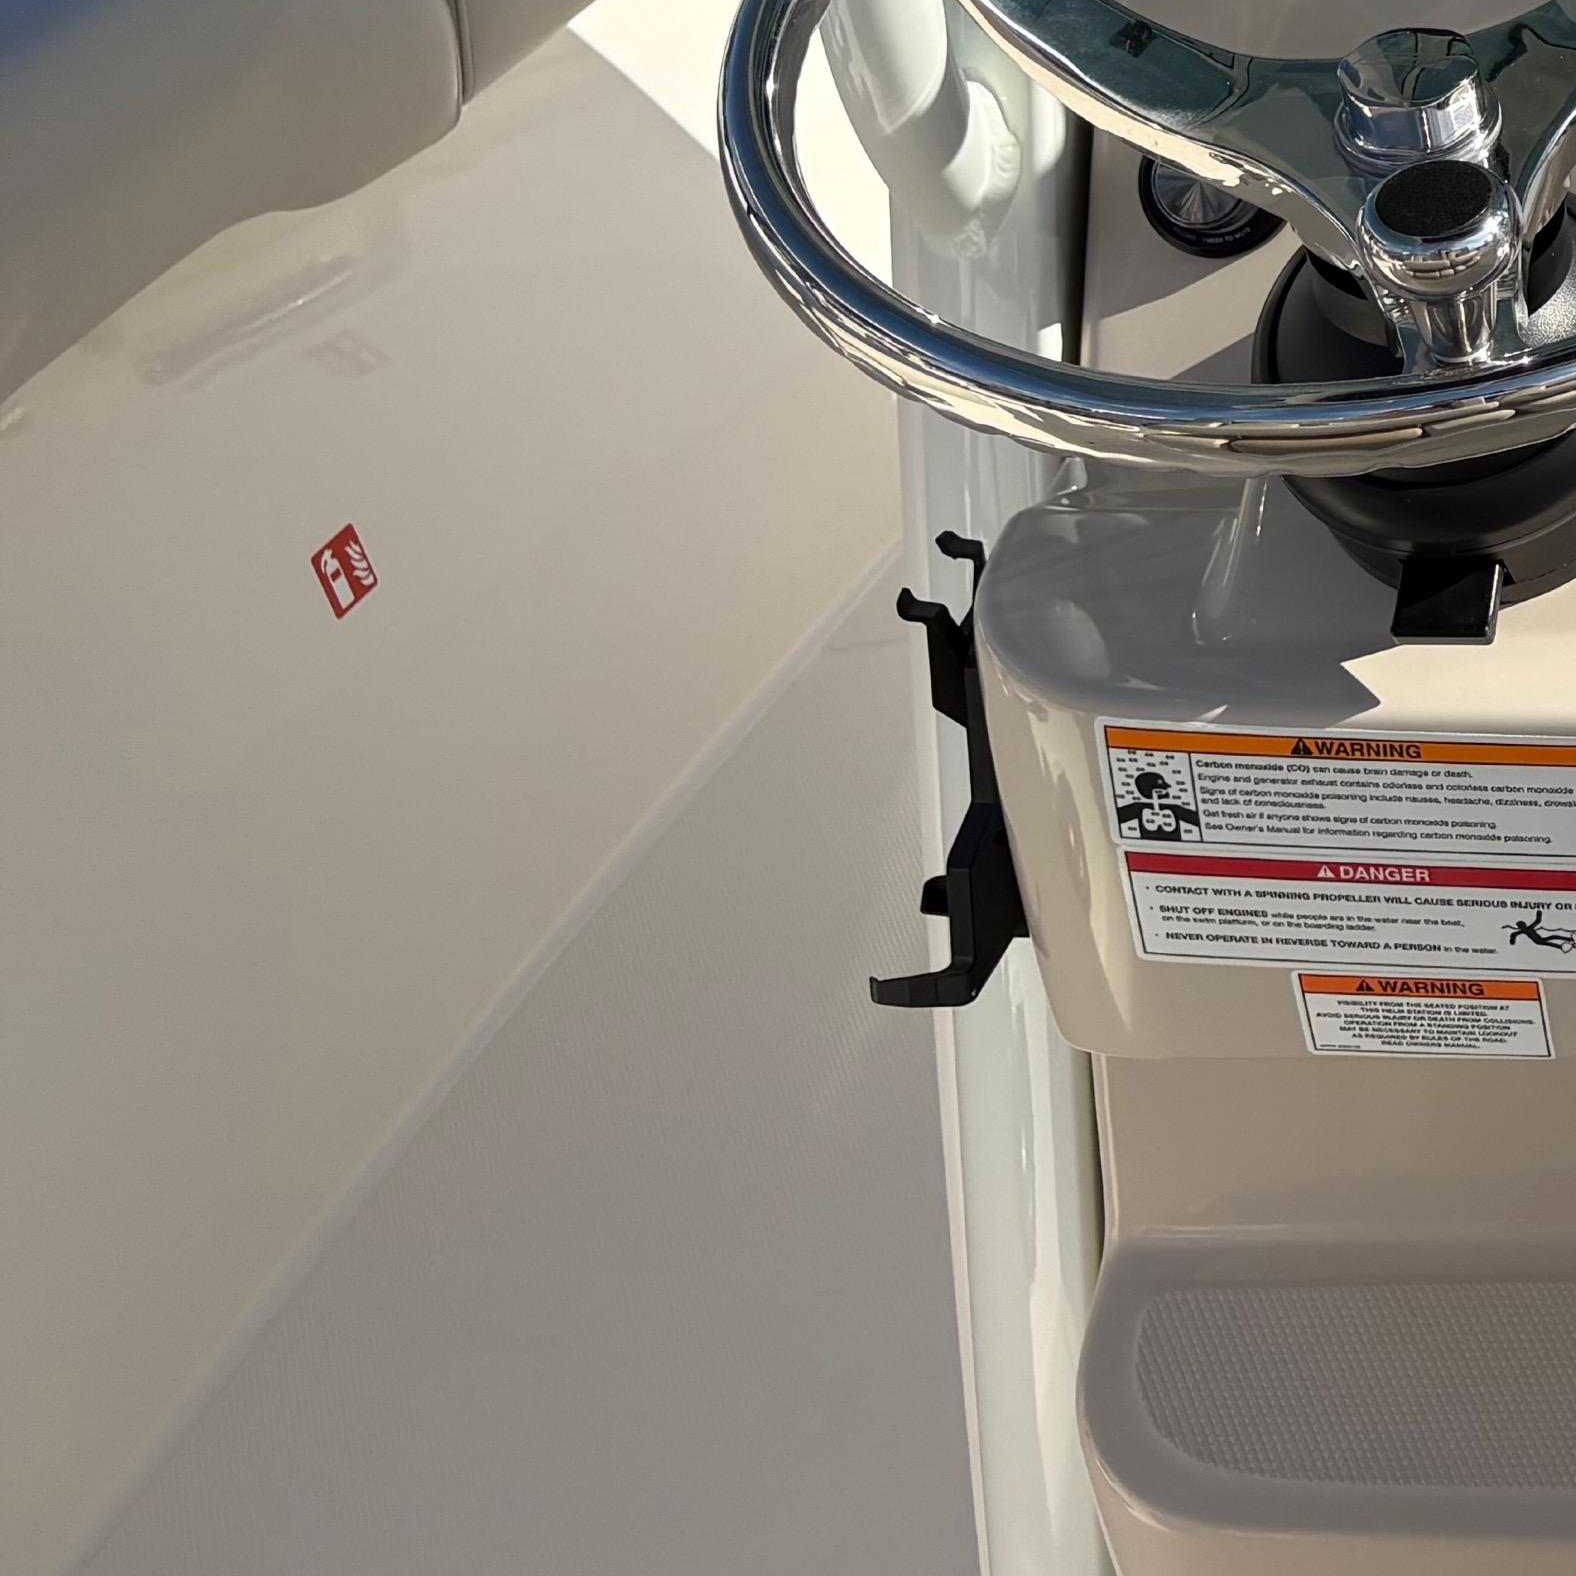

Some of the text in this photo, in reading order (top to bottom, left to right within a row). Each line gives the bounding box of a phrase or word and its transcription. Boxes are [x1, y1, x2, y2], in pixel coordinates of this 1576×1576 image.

[1314, 740, 1422, 759] WARNING
[1194, 759, 1233, 769] Carbon
[1339, 865, 1430, 882] DANGER
[1154, 884, 1209, 896] CONTACT
[1211, 887, 1242, 897] WITH
[1243, 889, 1253, 897] A
[1254, 890, 1311, 900] SPINNING
[1312, 892, 1381, 903] PROPELLER
[1383, 895, 1413, 905] WILL
[1413, 896, 1454, 906] CAUSE
[1509, 900, 1552, 910] INJURY
[1554, 902, 1572, 910] OR
[1158, 904, 1268, 918] SHUT OFF ENGINES
[1165, 931, 1204, 941] NEVER
[1205, 933, 1258, 944] OPERATE
[1275, 937, 1328, 947] REVERSE
[1329, 939, 1381, 950] TOWARD
[1382, 942, 1392, 950] A
[1393, 942, 1442, 952] PERSON
[1377, 979, 1485, 996] WARNING
